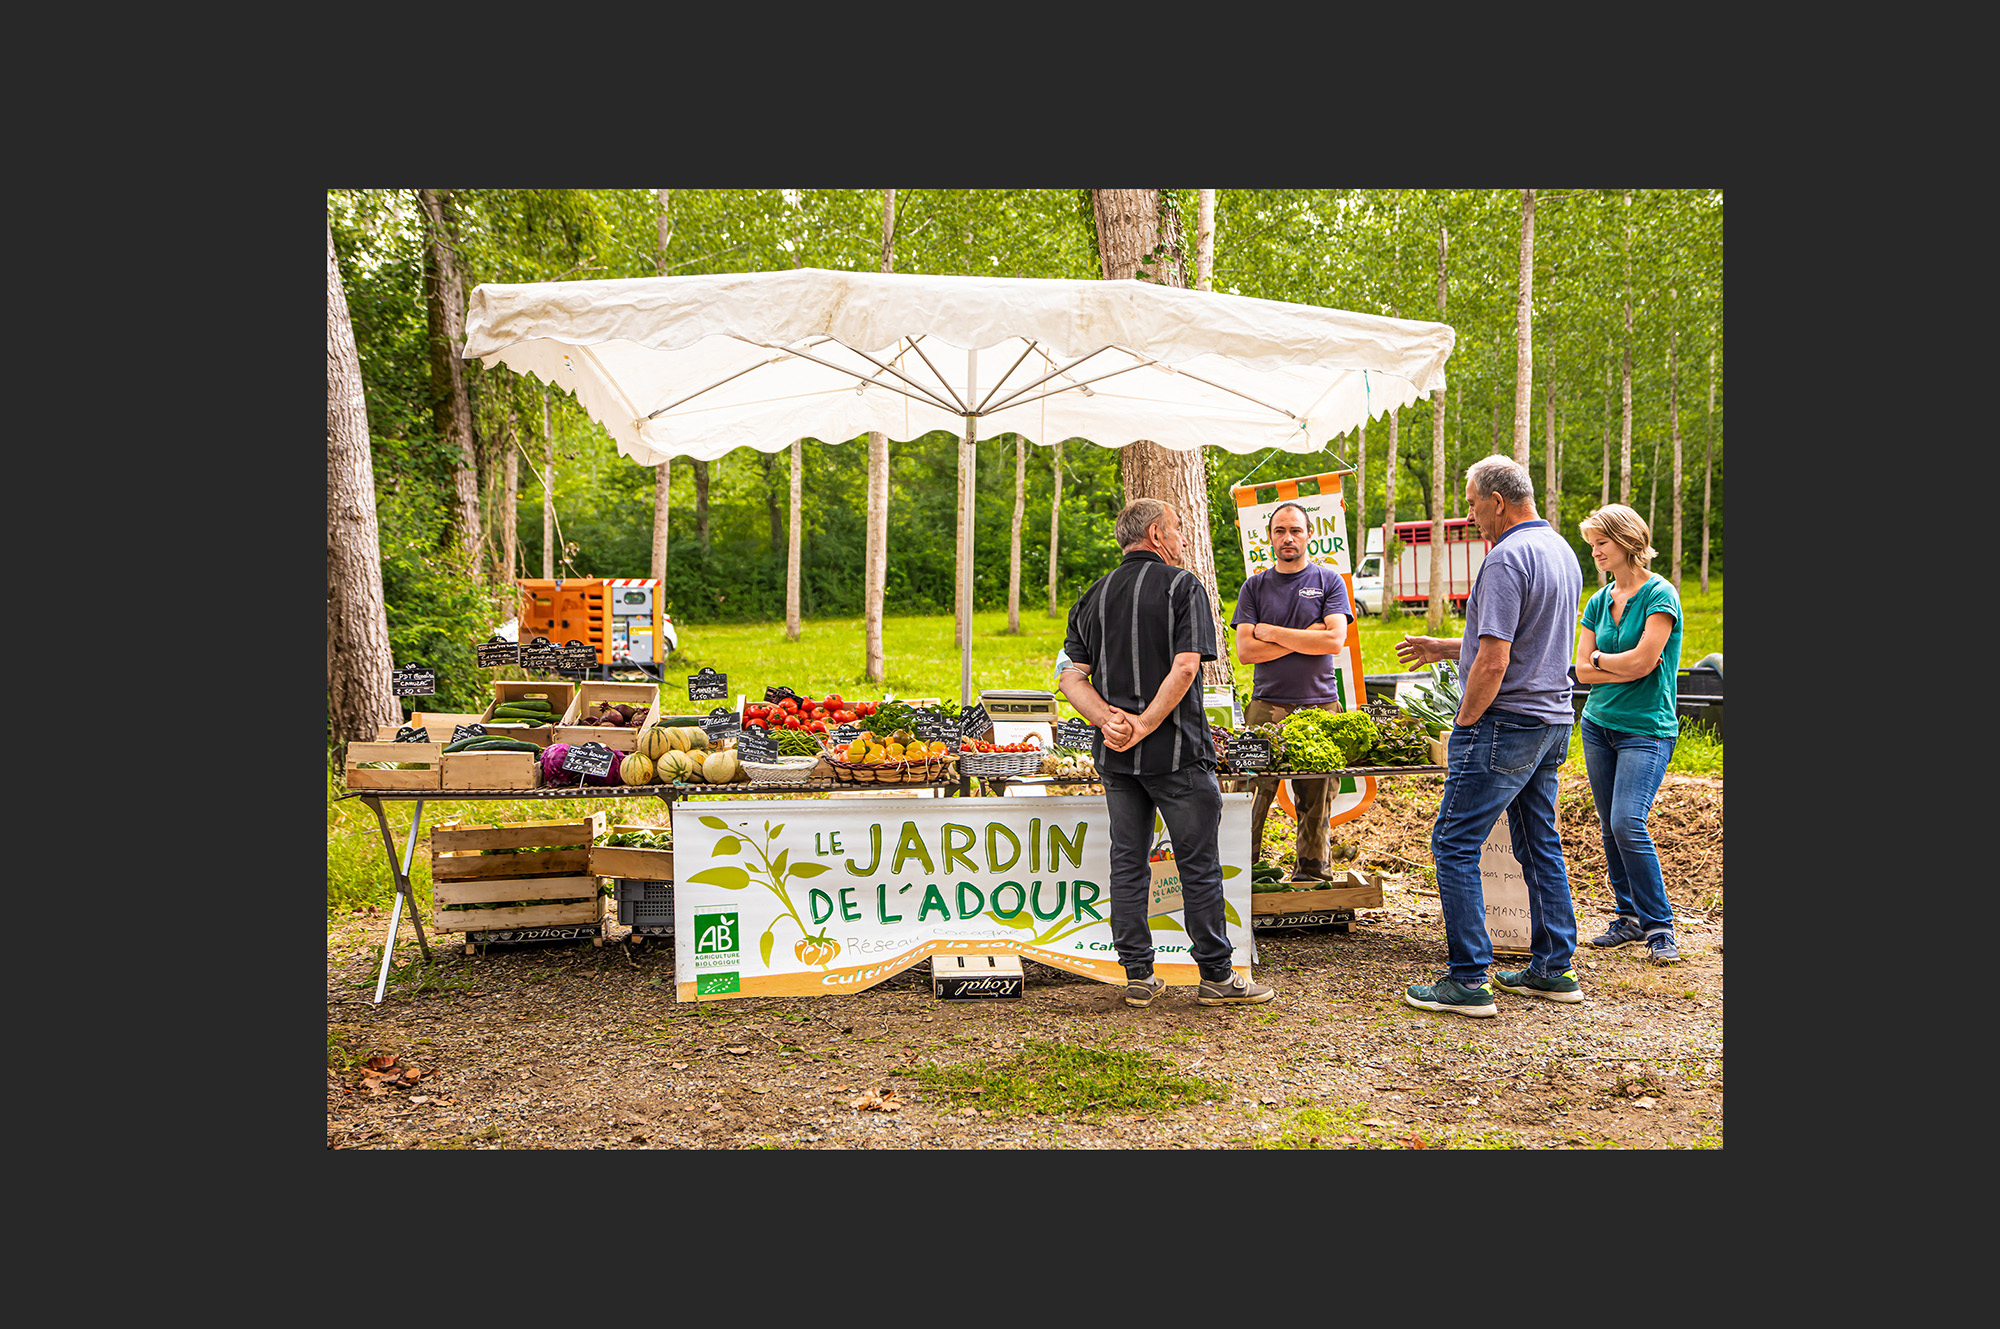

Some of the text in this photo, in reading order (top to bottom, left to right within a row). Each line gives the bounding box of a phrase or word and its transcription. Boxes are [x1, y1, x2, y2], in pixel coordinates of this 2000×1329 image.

[1247, 530, 1264, 540] LE
[1249, 549, 1268, 563] DE
[815, 817, 1089, 877] LE JARDIN
[808, 886, 862, 925] DE
[1490, 927, 1519, 939] NOUS
[1075, 941, 1084, 950] à
[694, 953, 740, 961] AGRICULTURE
[695, 959, 740, 967] BIOLOGIQUE
[821, 941, 1096, 986] Cultivons la solidarité
[954, 976, 1019, 996] Royal
